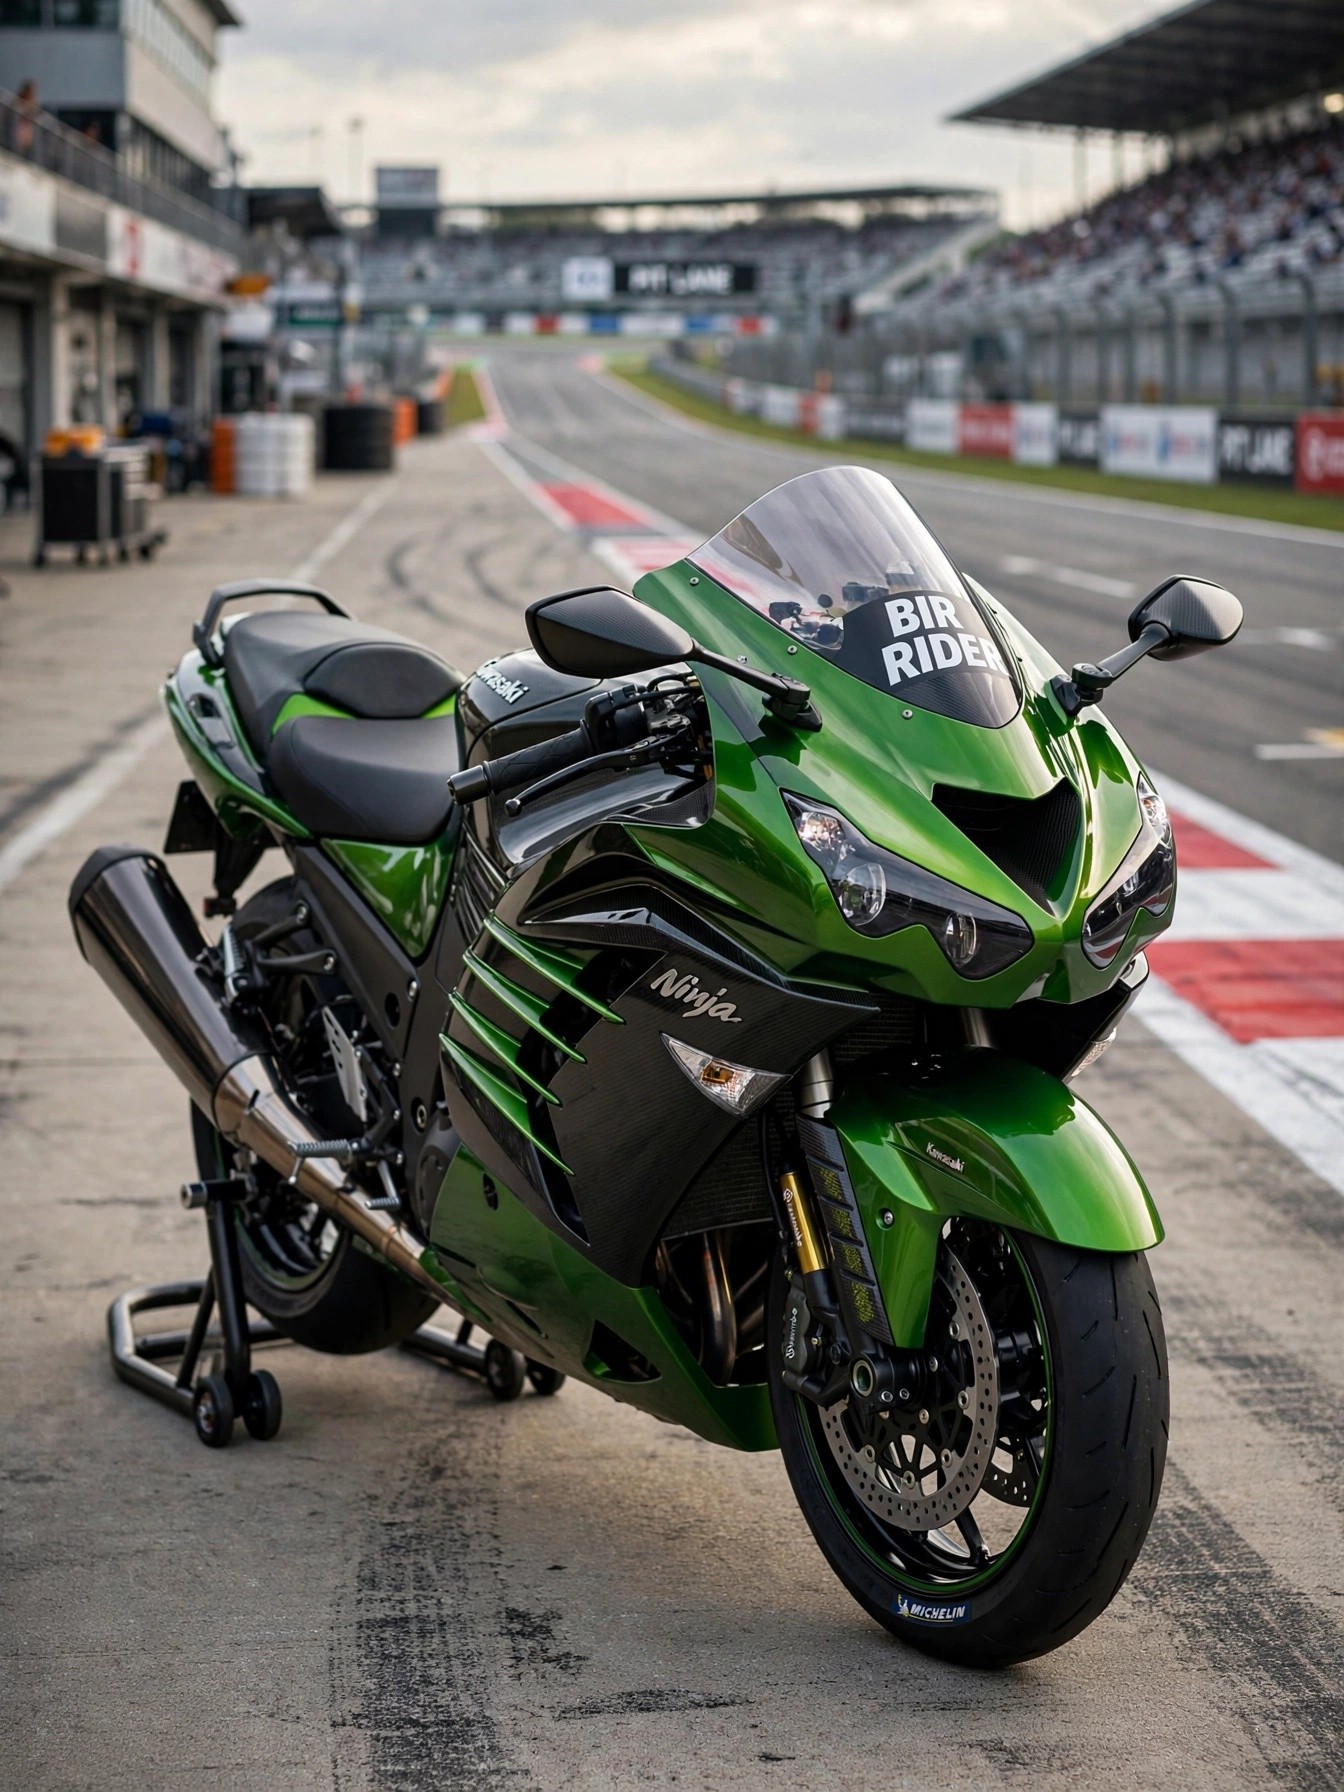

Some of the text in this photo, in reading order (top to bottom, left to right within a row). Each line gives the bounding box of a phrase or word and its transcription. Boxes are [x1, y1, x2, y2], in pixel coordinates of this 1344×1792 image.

[885, 595, 964, 637] BIR
[881, 633, 1010, 687] RIDER
[650, 968, 742, 1022] Ninja
[910, 1603, 966, 1619] MICHELIN
